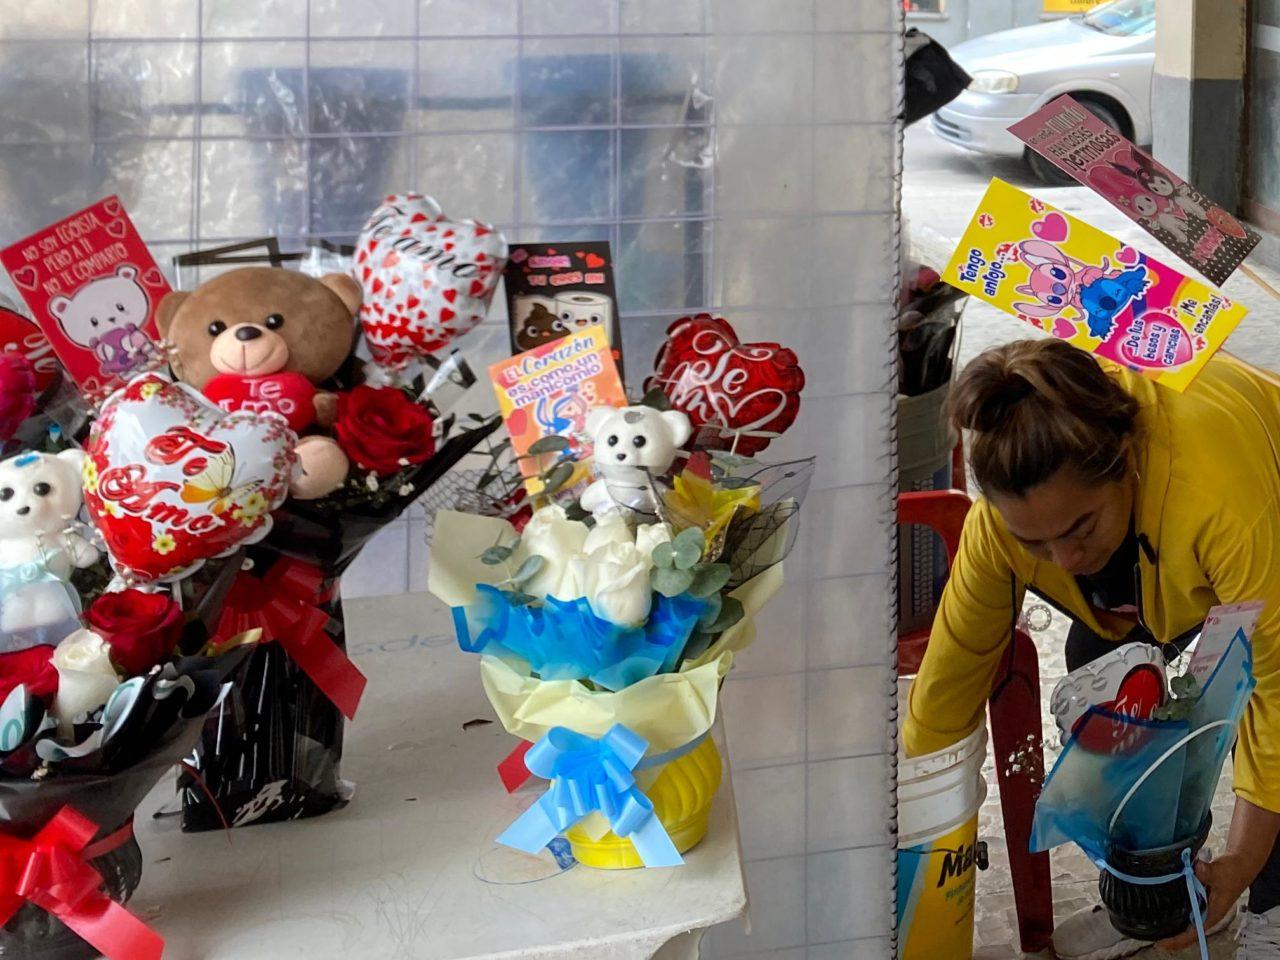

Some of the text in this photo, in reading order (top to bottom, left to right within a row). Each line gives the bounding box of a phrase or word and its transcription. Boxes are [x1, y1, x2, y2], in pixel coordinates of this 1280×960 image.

[960, 249, 986, 282] Tengo
[505, 337, 594, 381] EL Corazón
[1143, 324, 1167, 359] besos y
[1163, 328, 1181, 365] caricias
[508, 353, 599, 397] es como un
[515, 364, 601, 407] manicomio
